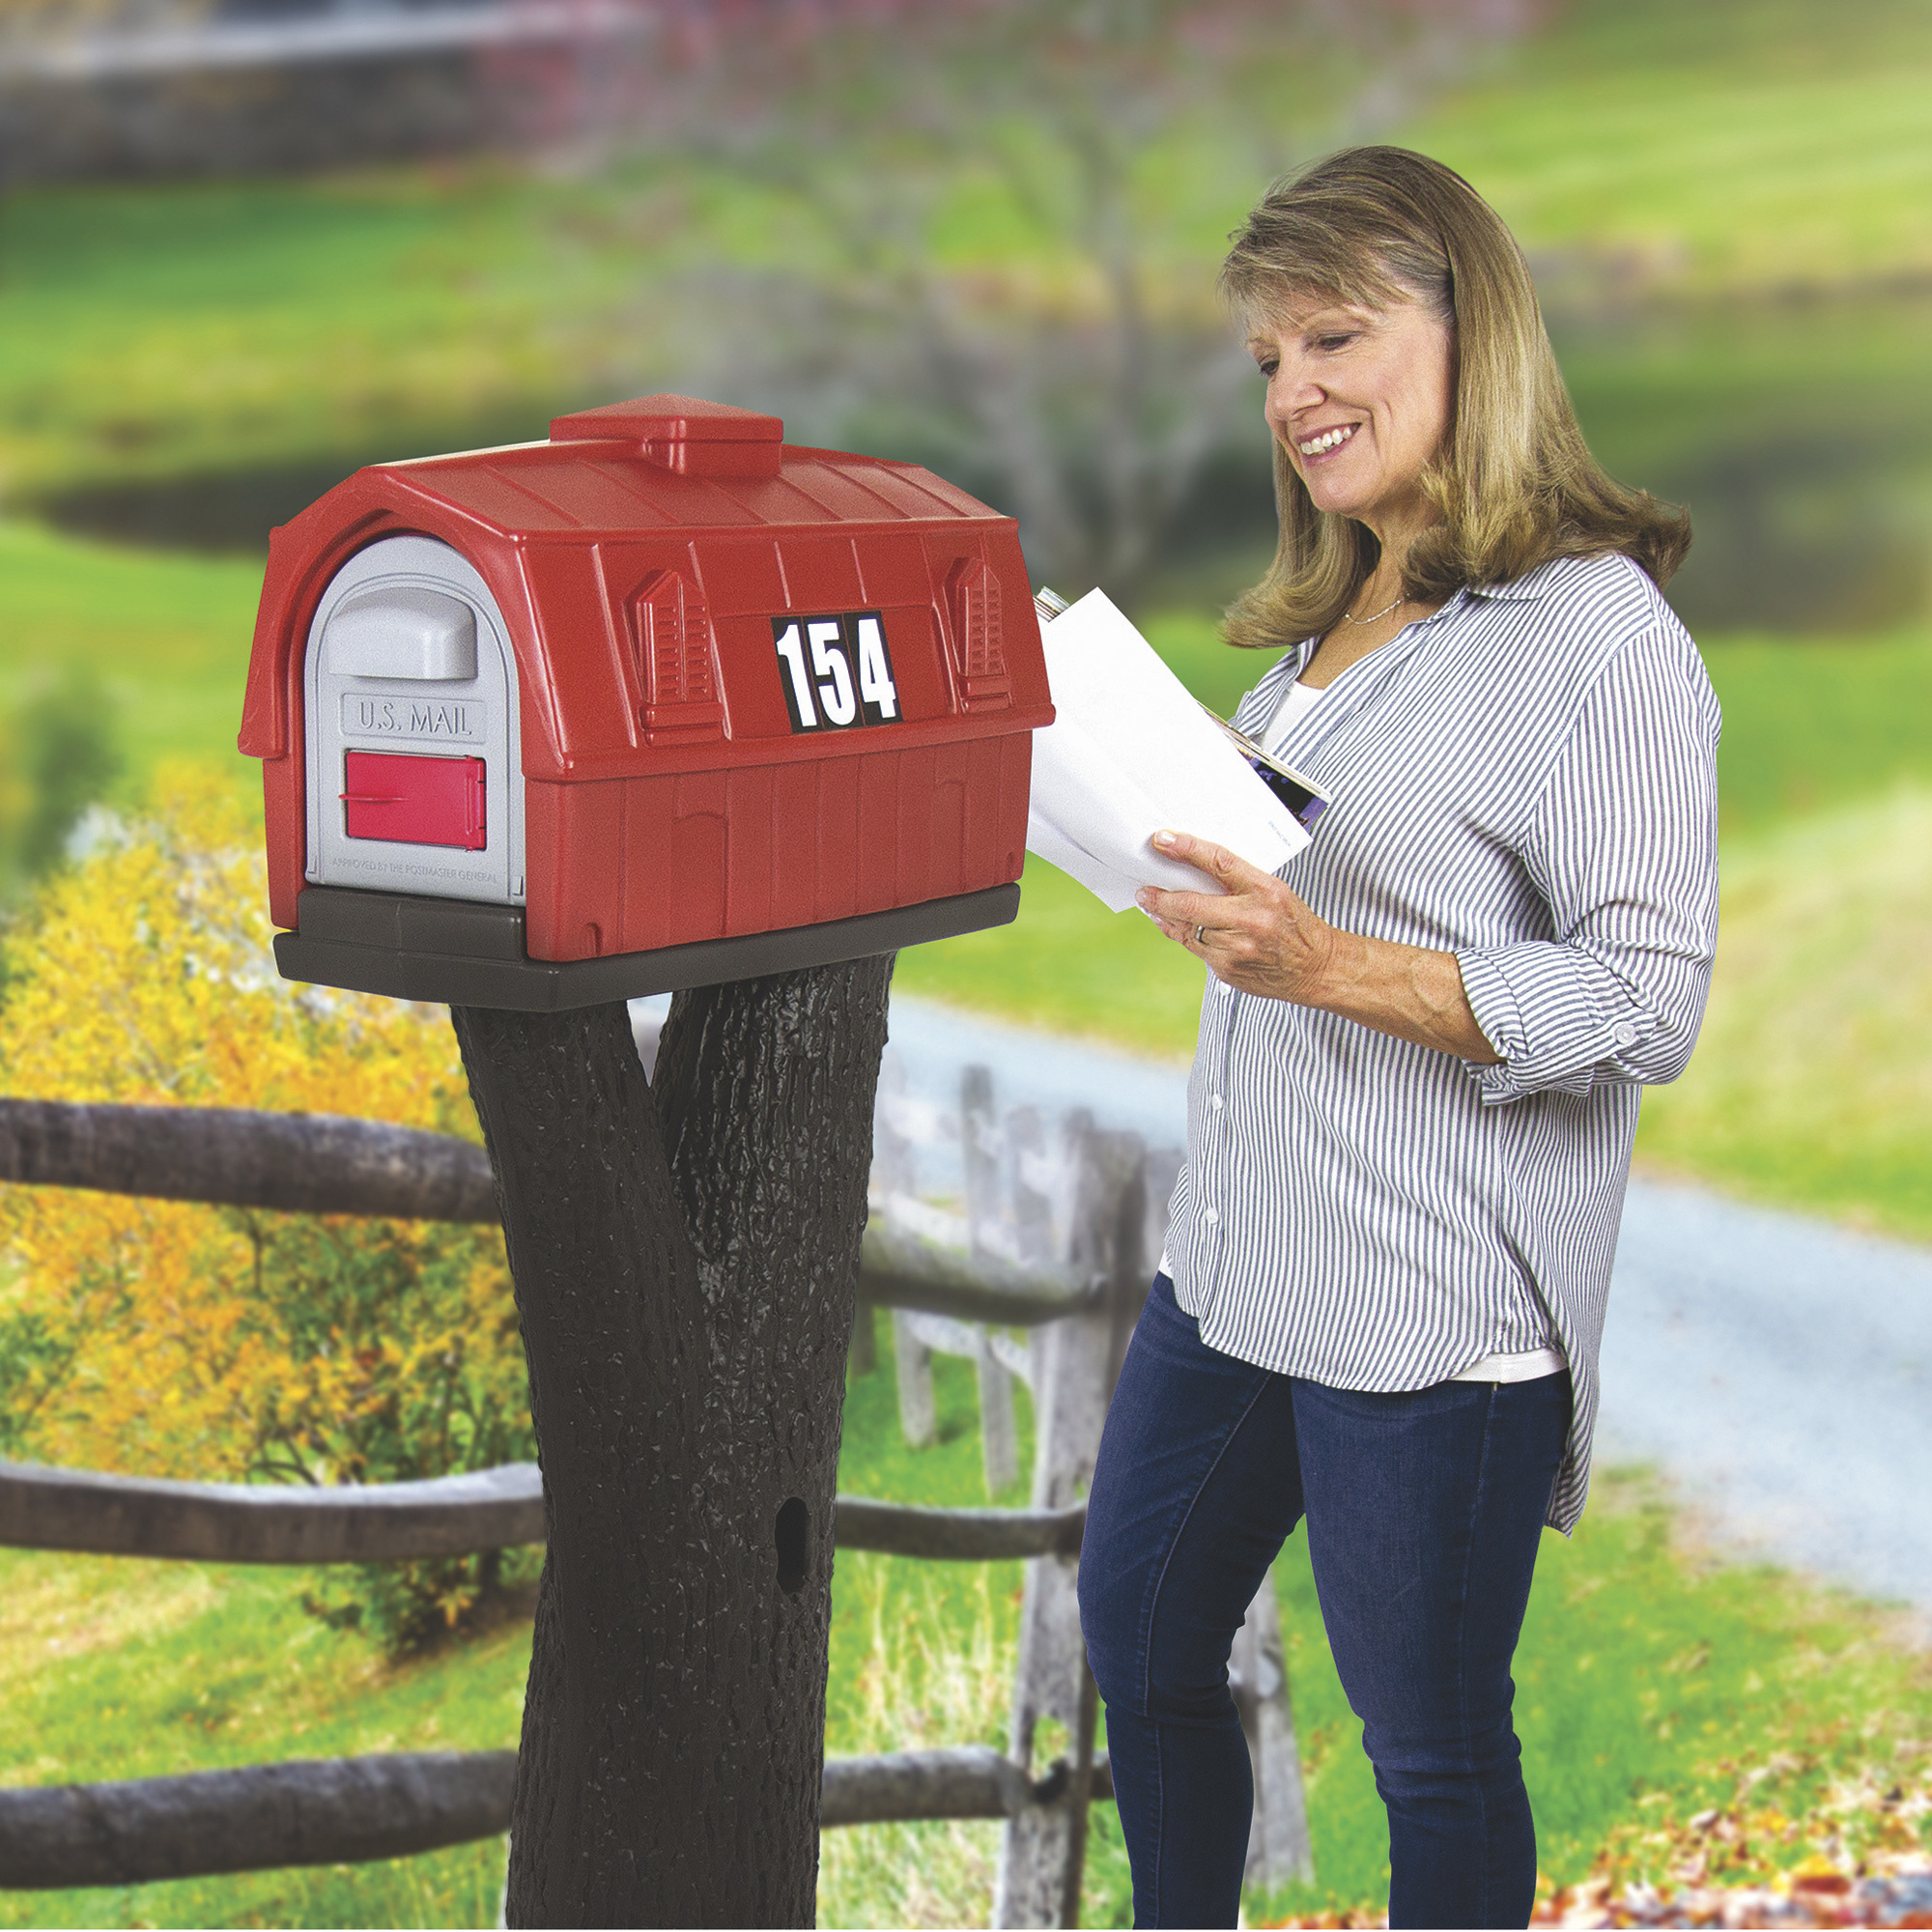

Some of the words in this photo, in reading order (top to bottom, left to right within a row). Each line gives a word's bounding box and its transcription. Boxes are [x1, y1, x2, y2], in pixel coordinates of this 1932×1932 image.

[776, 618, 896, 726] 154
[360, 701, 402, 731] U.S.
[411, 704, 472, 736] MAIL
[331, 857, 376, 870] APPROVED
[377, 862, 387, 871] BY
[389, 863, 404, 873] THE
[405, 865, 457, 879] POSTMASTER
[458, 870, 497, 884] GENERAL
